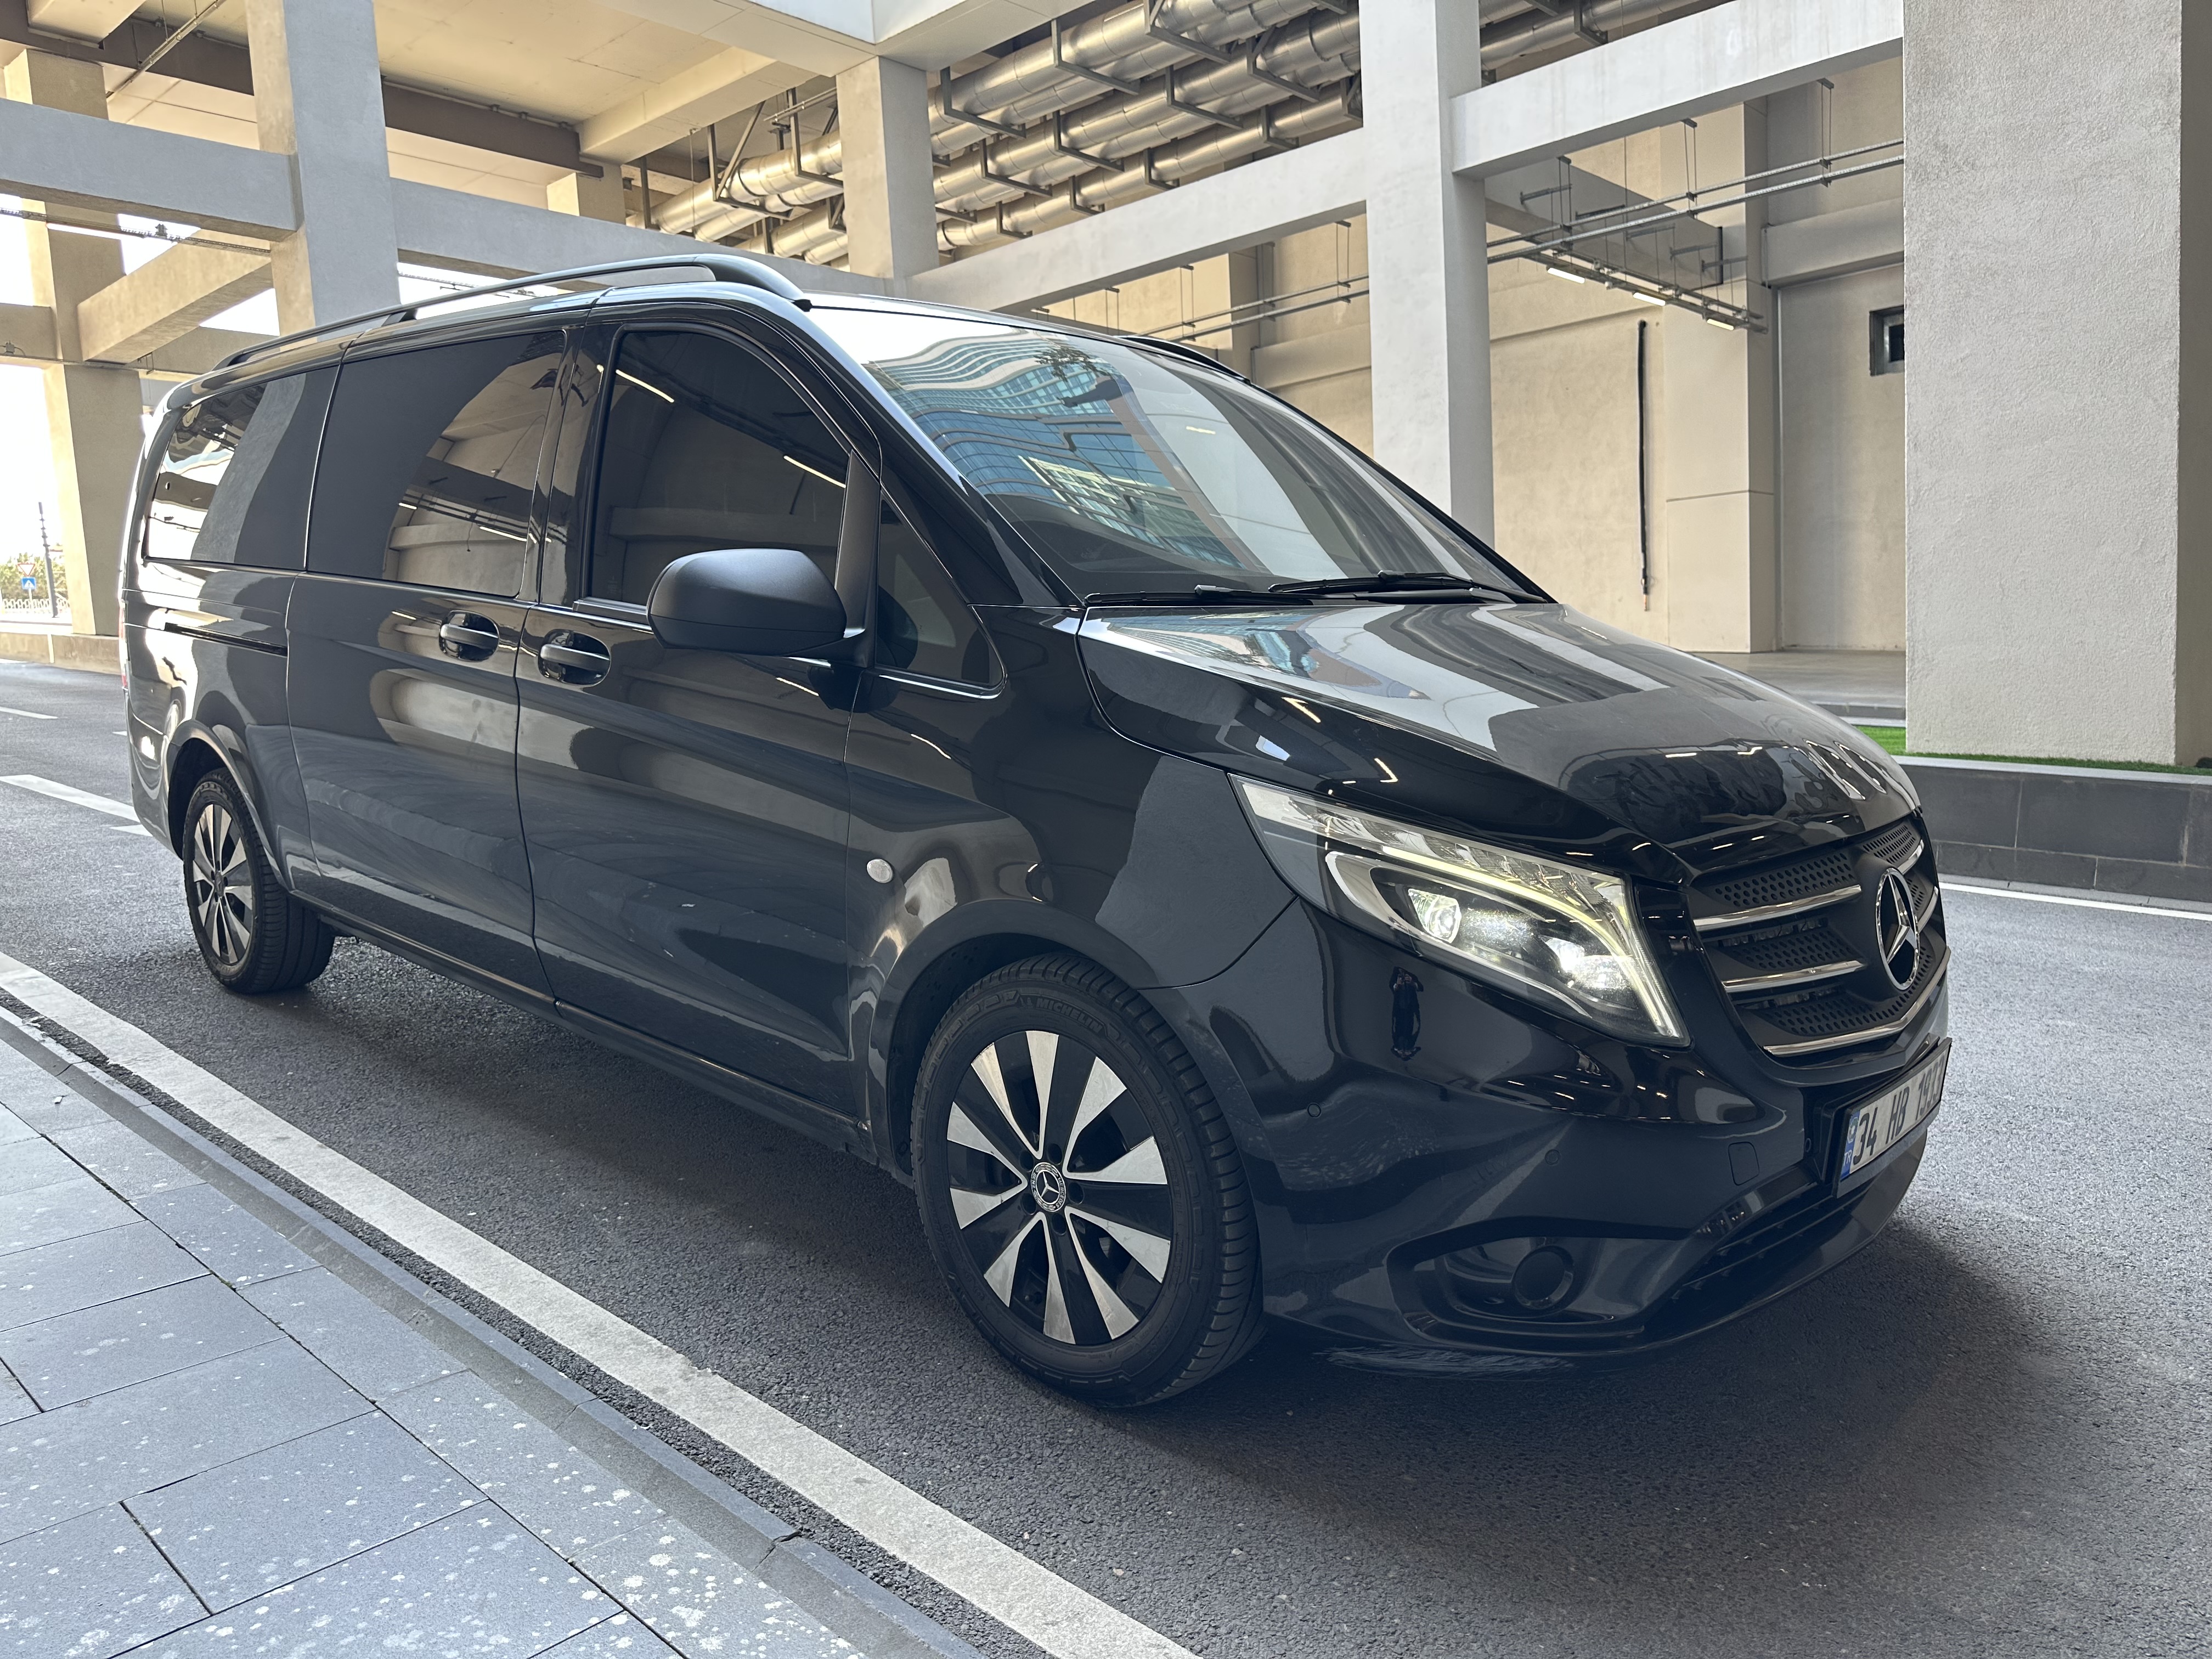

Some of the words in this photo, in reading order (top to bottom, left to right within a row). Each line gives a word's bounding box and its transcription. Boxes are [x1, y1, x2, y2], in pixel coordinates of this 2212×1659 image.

[1036, 997, 1103, 1032] MICHELIN
[1853, 1107, 1878, 1165] 34
[1885, 1086, 1910, 1145] HB
[1843, 1149, 1852, 1166] TR
[1056, 1177, 1064, 1208] MERCEDES
